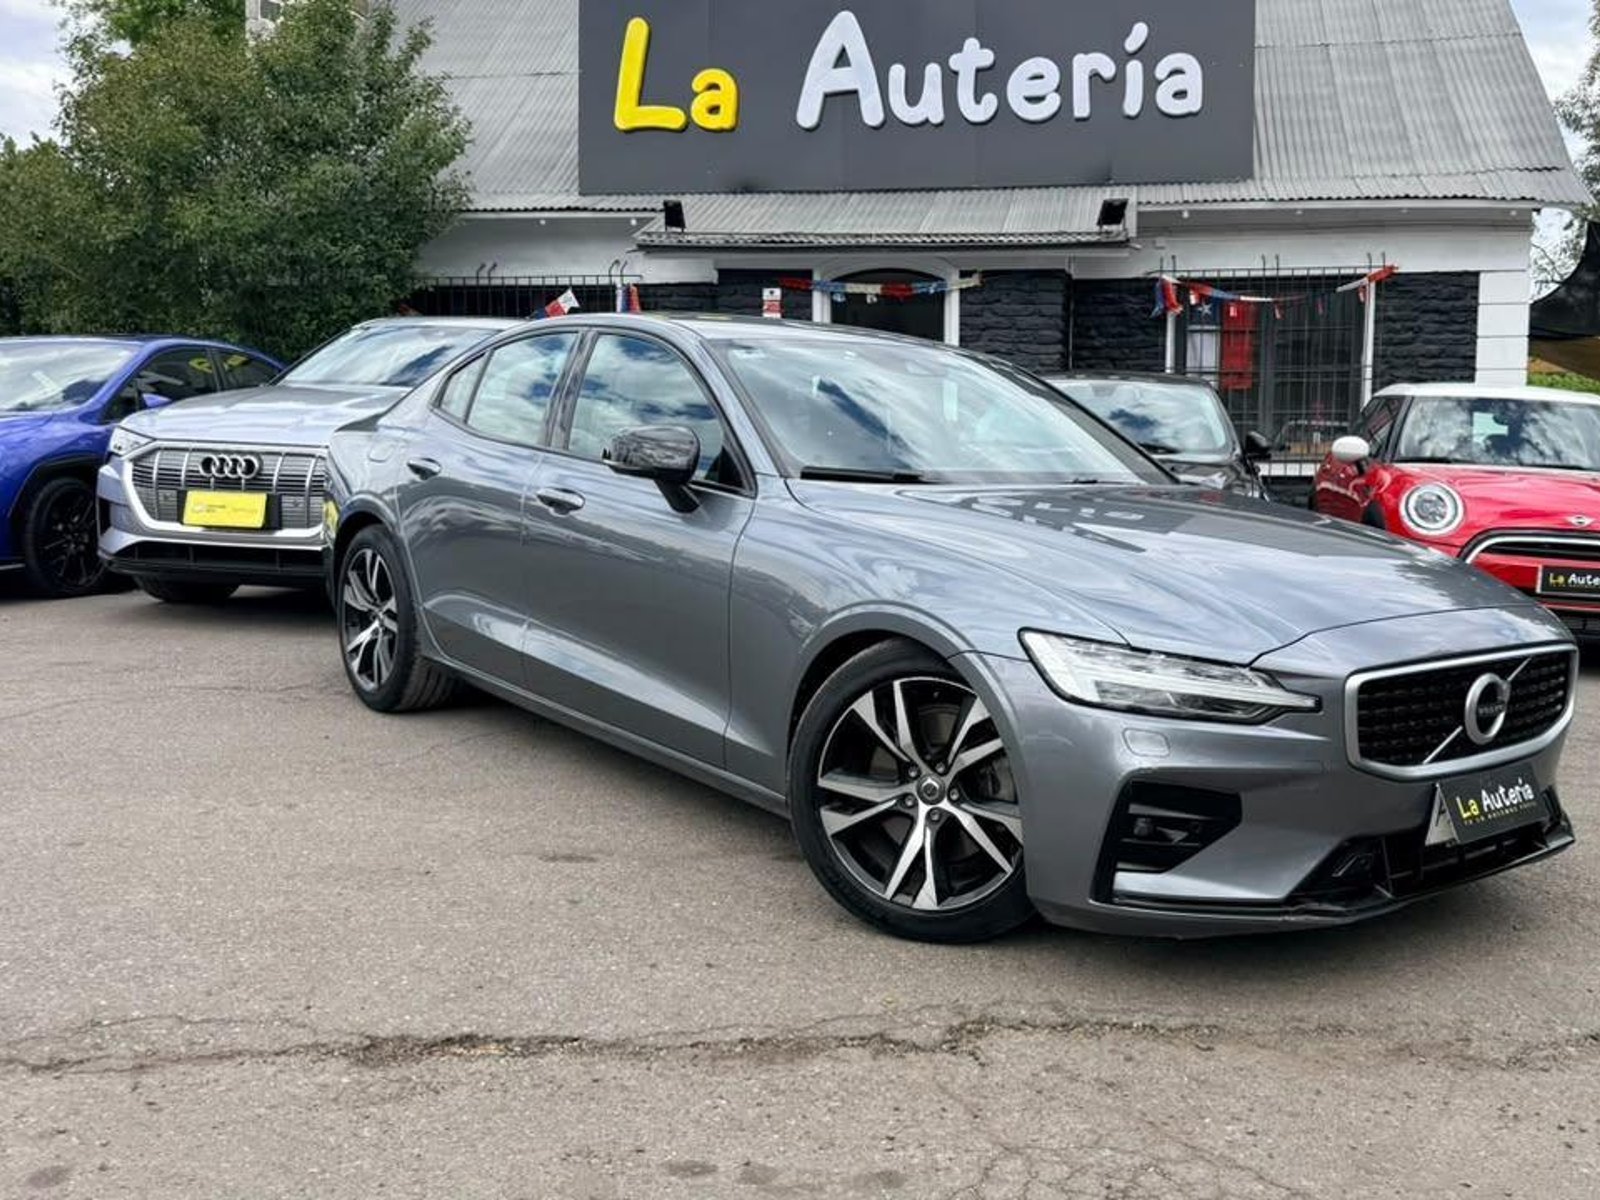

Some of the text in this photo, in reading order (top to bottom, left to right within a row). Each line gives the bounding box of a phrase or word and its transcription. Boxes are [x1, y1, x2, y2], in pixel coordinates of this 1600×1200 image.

[614, 10, 1203, 132] La Autería
[1456, 796, 1480, 819] La
